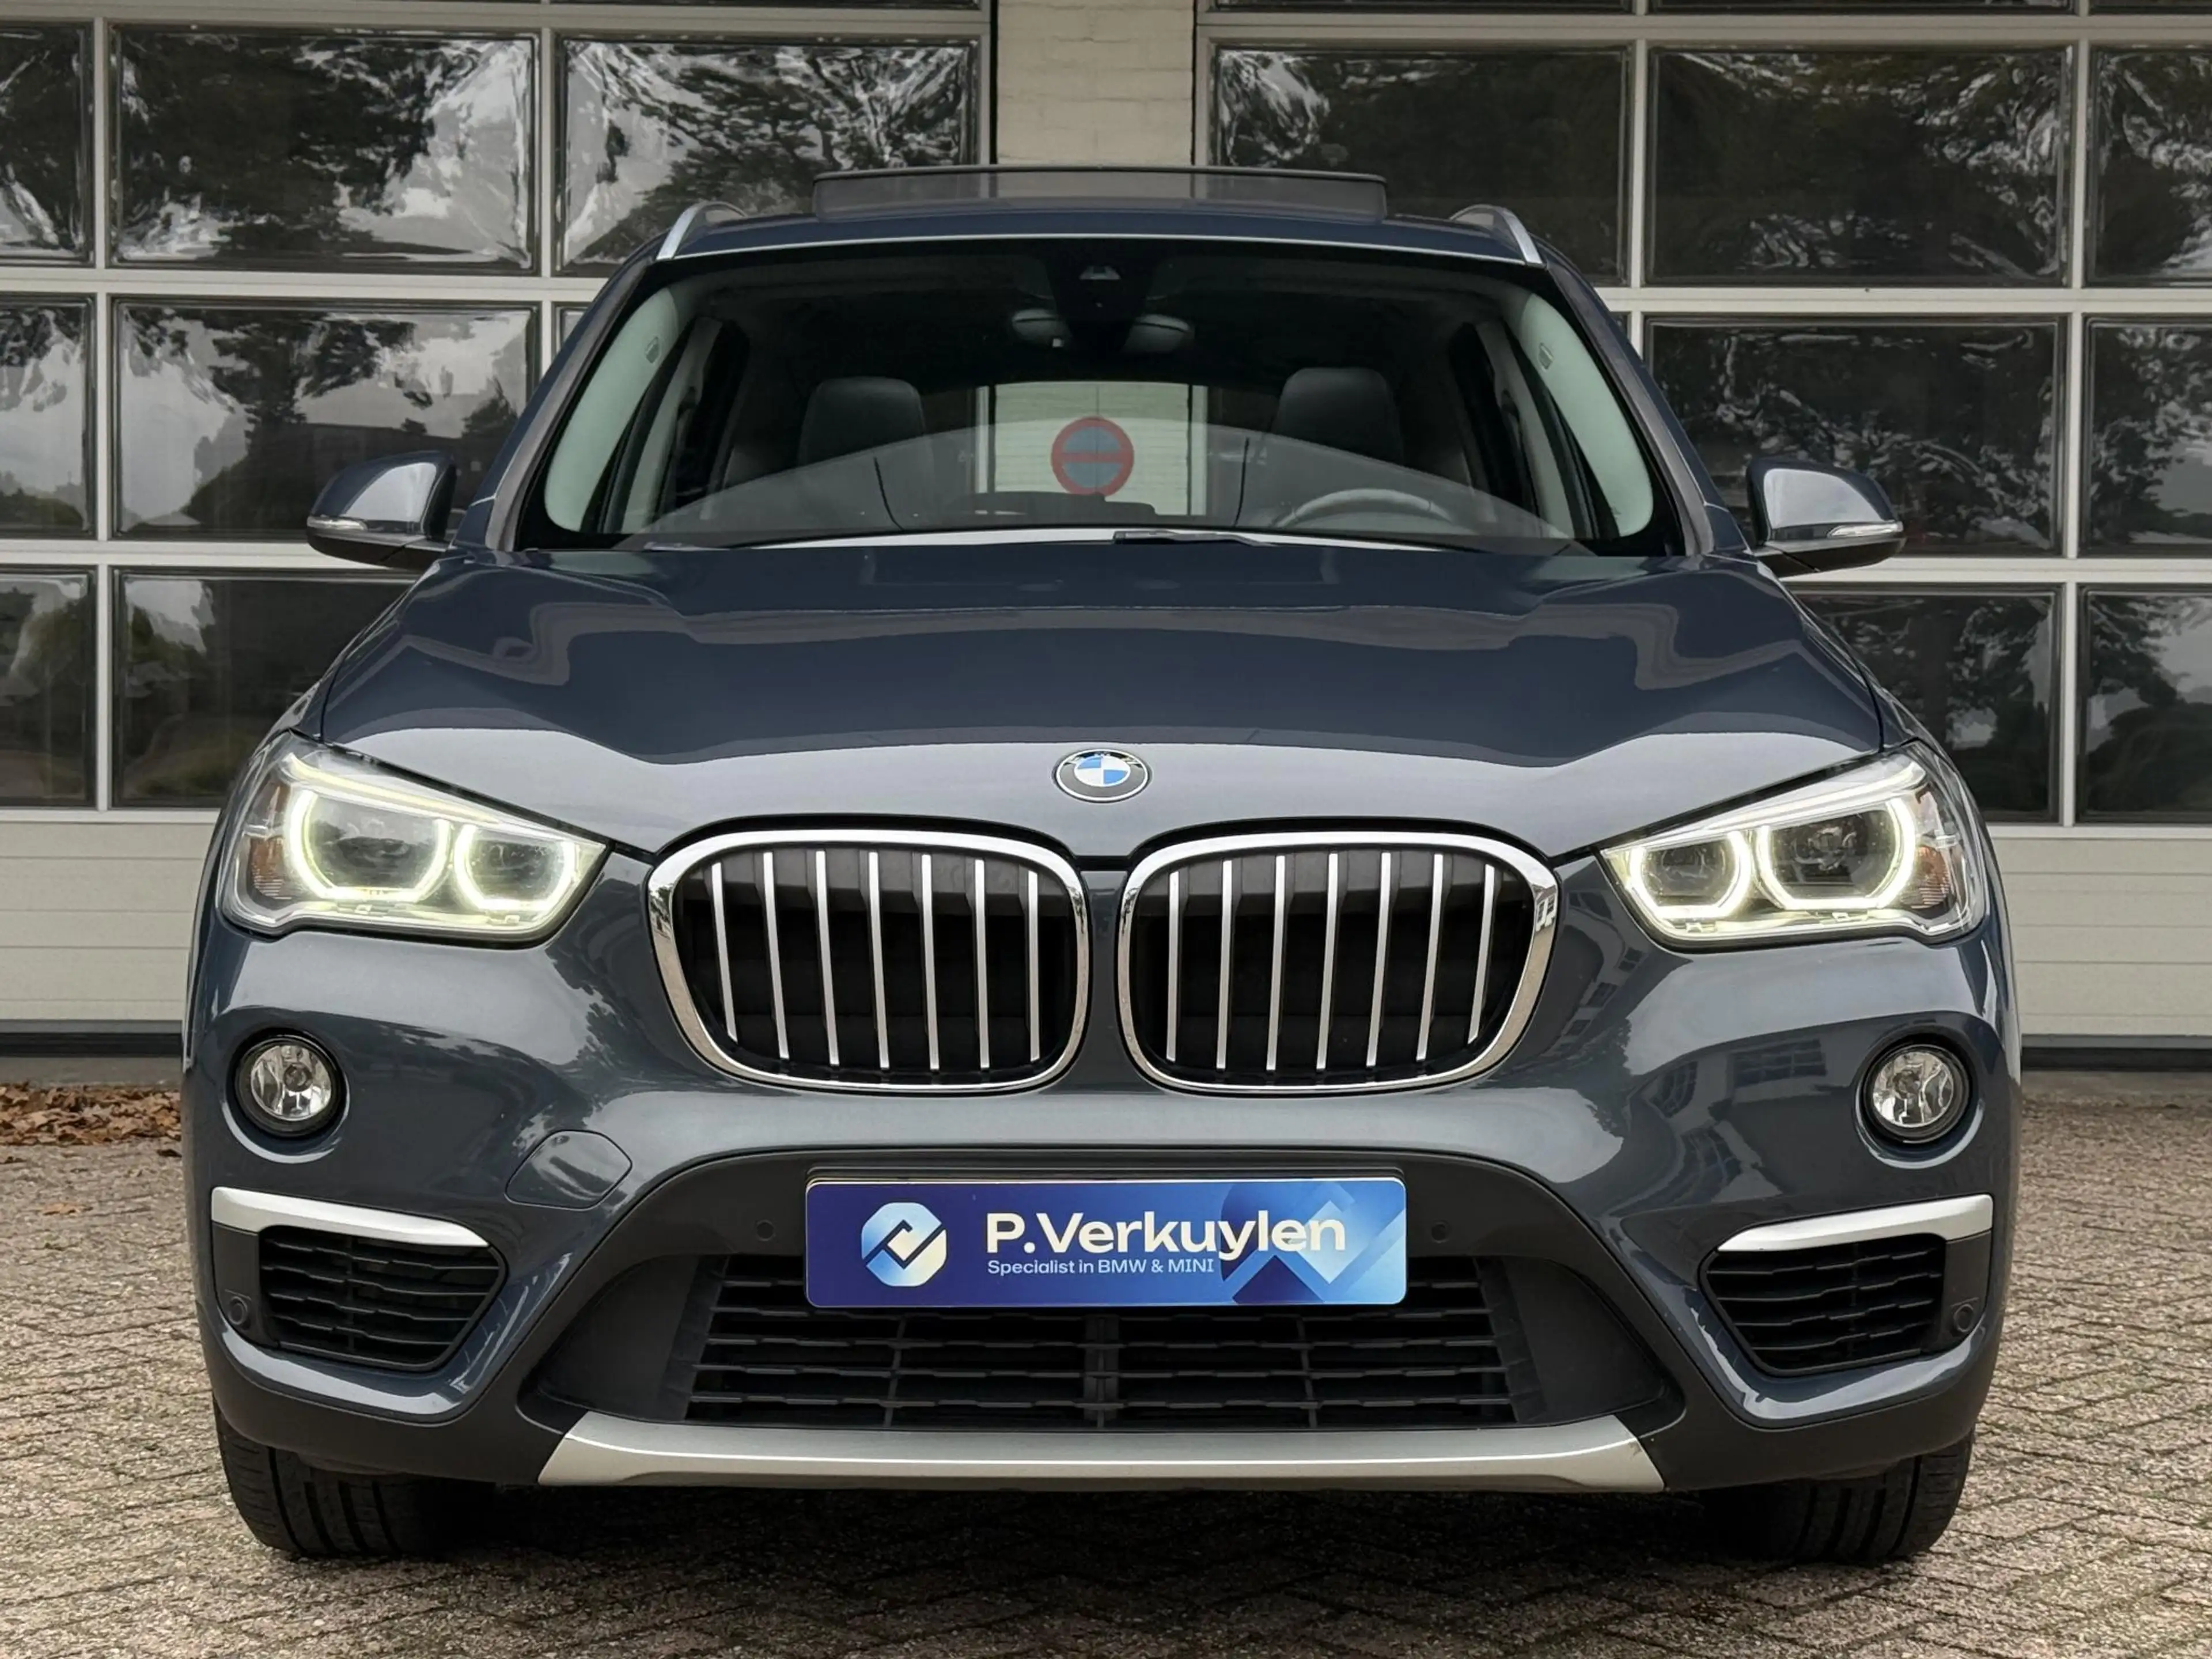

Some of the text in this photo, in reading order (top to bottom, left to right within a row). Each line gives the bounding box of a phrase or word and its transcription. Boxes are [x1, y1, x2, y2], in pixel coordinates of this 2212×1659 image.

[987, 1210, 1346, 1260] P.Verkuylen
[988, 1259, 1214, 1276] Specialist in BMW & MINI
